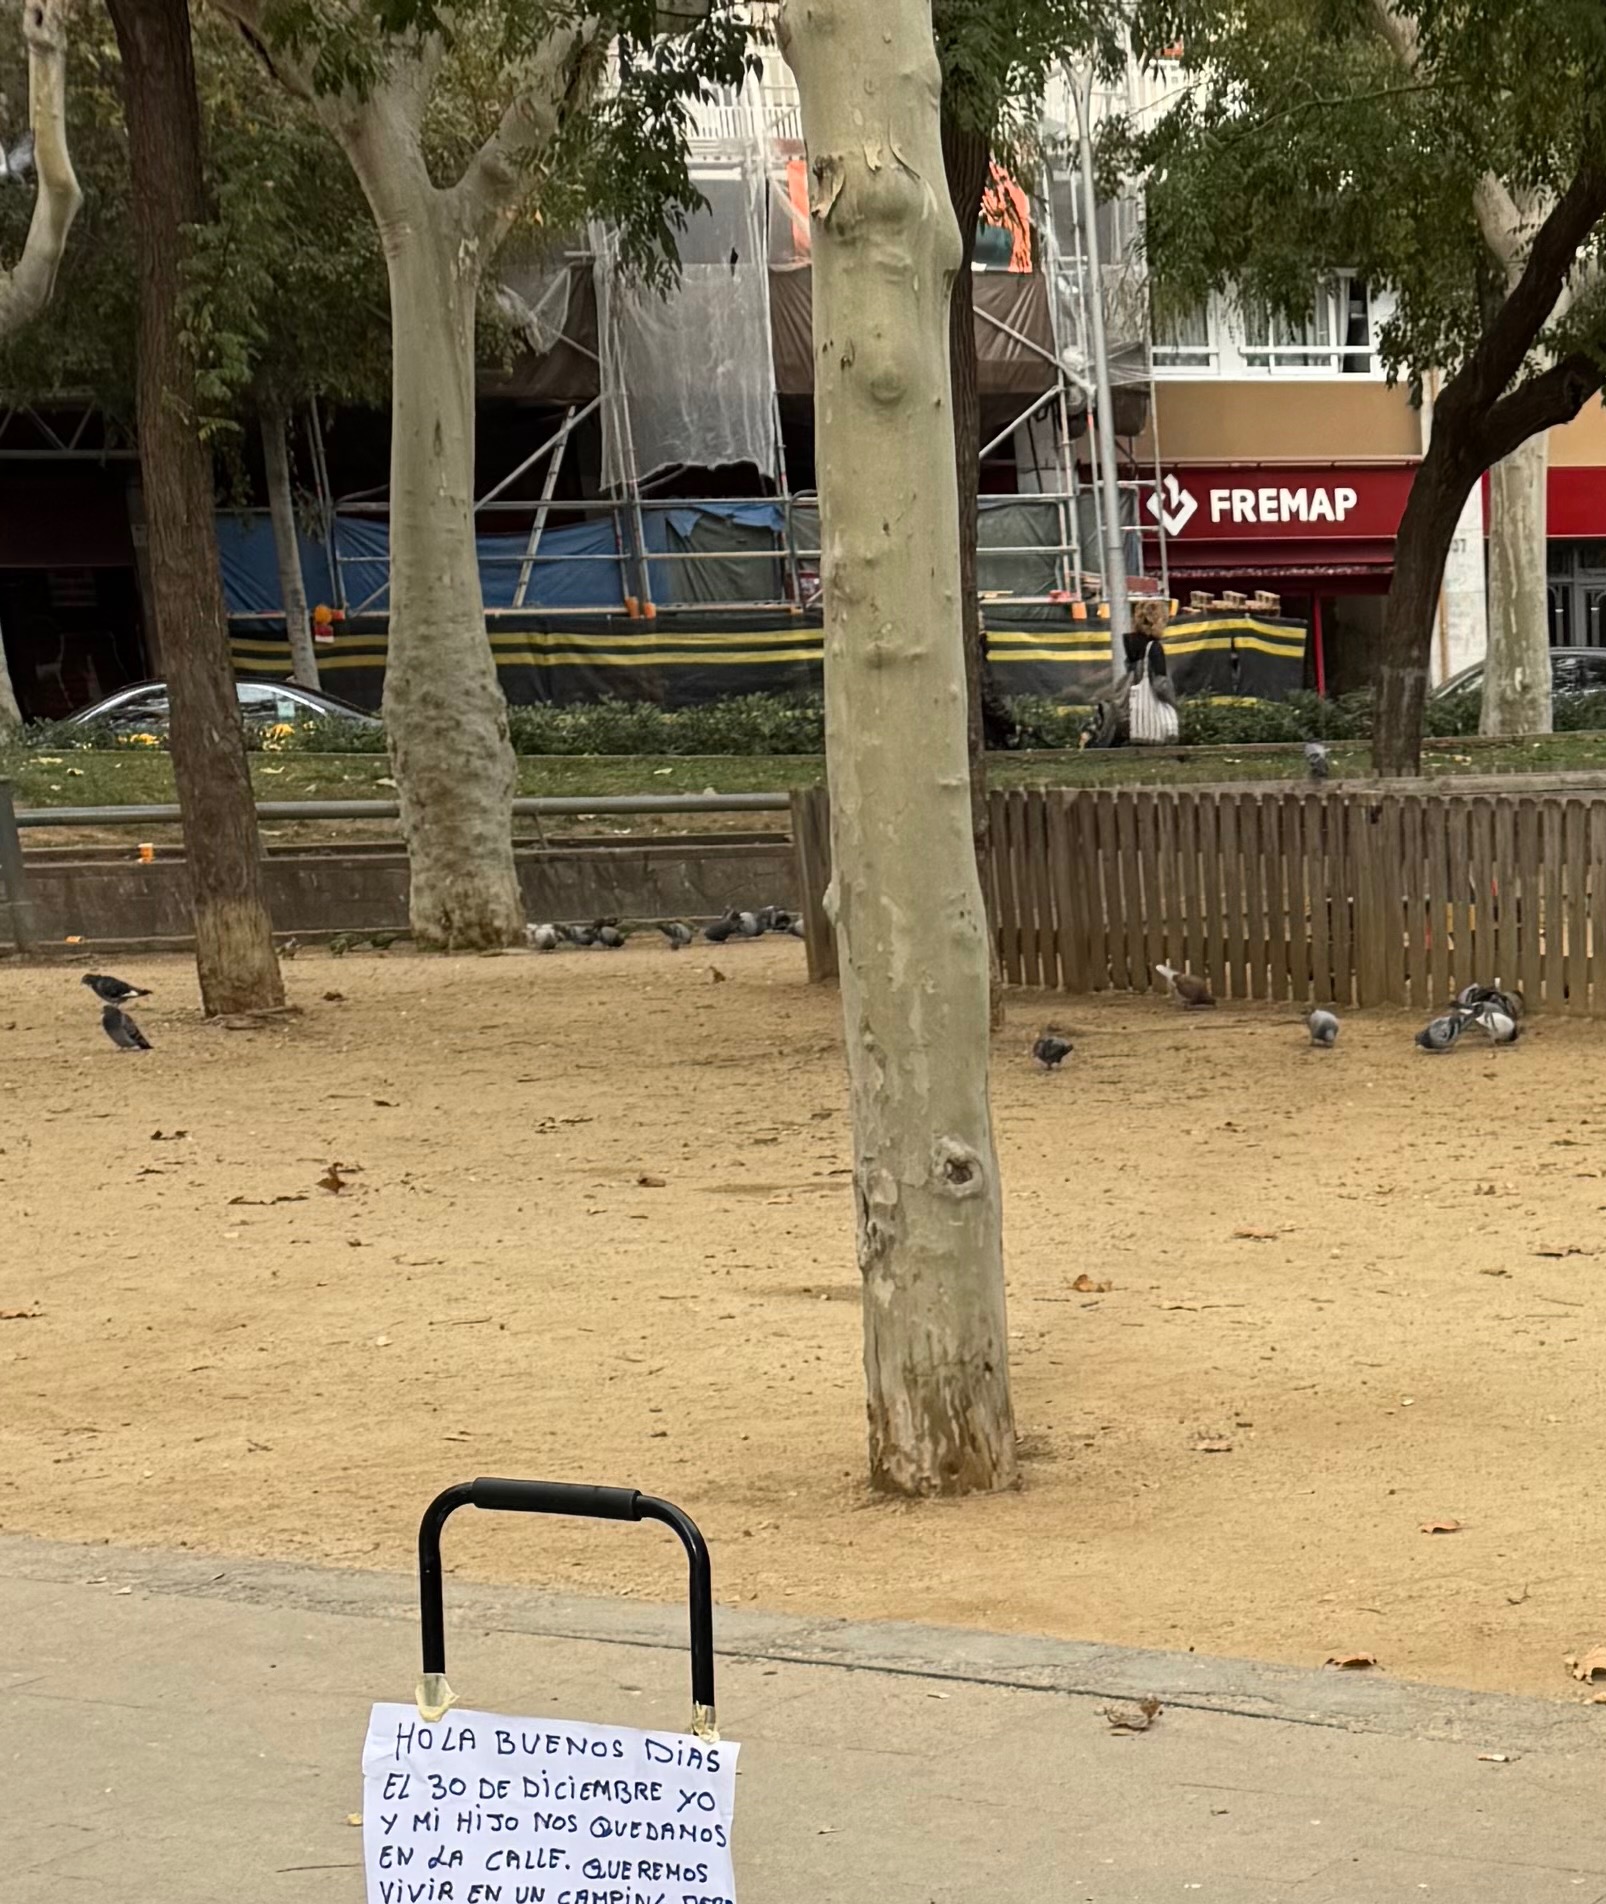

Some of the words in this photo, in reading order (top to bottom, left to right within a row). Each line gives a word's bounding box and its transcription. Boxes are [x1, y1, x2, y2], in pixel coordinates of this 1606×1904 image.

[1210, 487, 1358, 523] FREMAP
[396, 1723, 476, 1760] HOLA
[495, 1730, 624, 1757] BUENOS
[383, 1773, 411, 1800] EL
[428, 1774, 467, 1798] 30
[479, 1778, 511, 1800] DE
[523, 1770, 663, 1804] DICIEMBRE
[676, 1788, 716, 1813] YO
[380, 1813, 398, 1834] Y
[412, 1807, 440, 1832] MI
[457, 1804, 519, 1832] HIJO
[534, 1812, 578, 1833] NOS
[590, 1815, 728, 1848] QUEDAMOS
[379, 1845, 414, 1869] EN
[427, 1845, 463, 1869] LA
[485, 1848, 571, 1871] CALLE.
[582, 1858, 708, 1883] QUEREMOS
[379, 1877, 454, 1904] VIVIR
[467, 1883, 502, 1904] EN
[515, 1886, 546, 1904] UN
